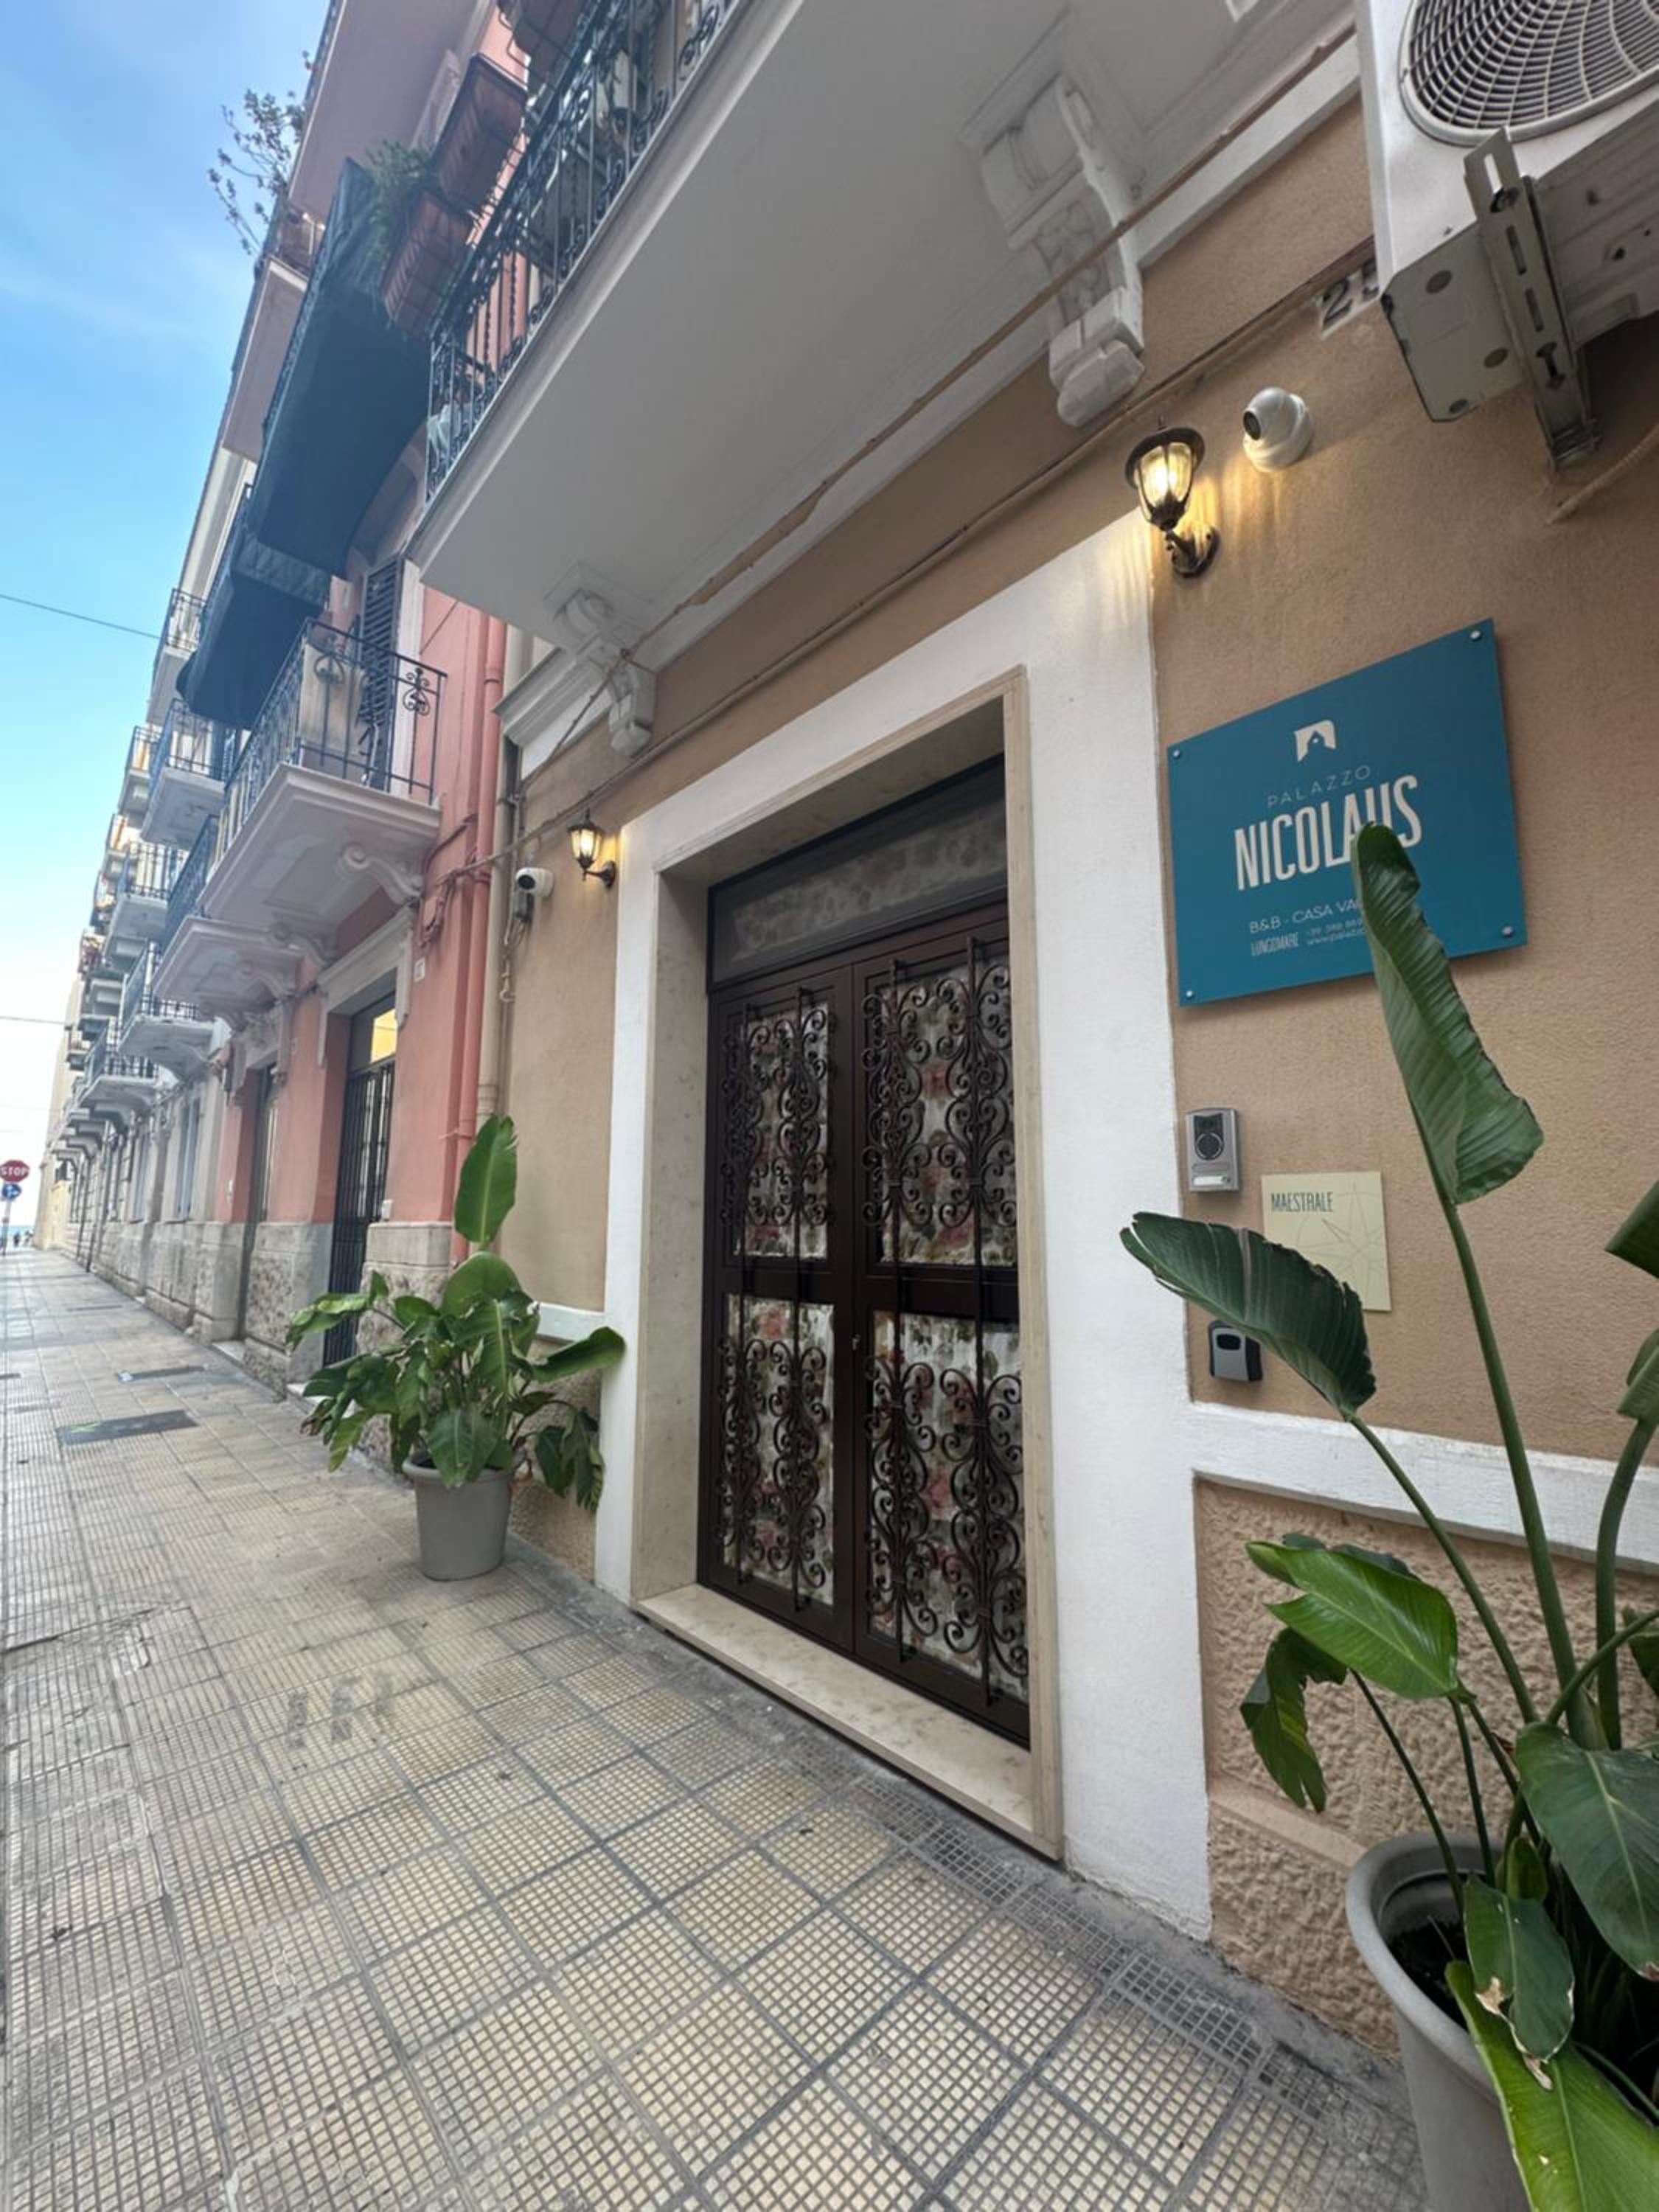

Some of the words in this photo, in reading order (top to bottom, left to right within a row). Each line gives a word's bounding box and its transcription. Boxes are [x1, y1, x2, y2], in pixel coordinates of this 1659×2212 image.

[1267, 765, 1371, 809] PALAZZO
[1250, 915, 1281, 934] B&B
[1292, 904, 1333, 923] CASA
[0, 1166, 28, 1176] STOP
[1270, 1192, 1333, 1212] MAESTRALE
